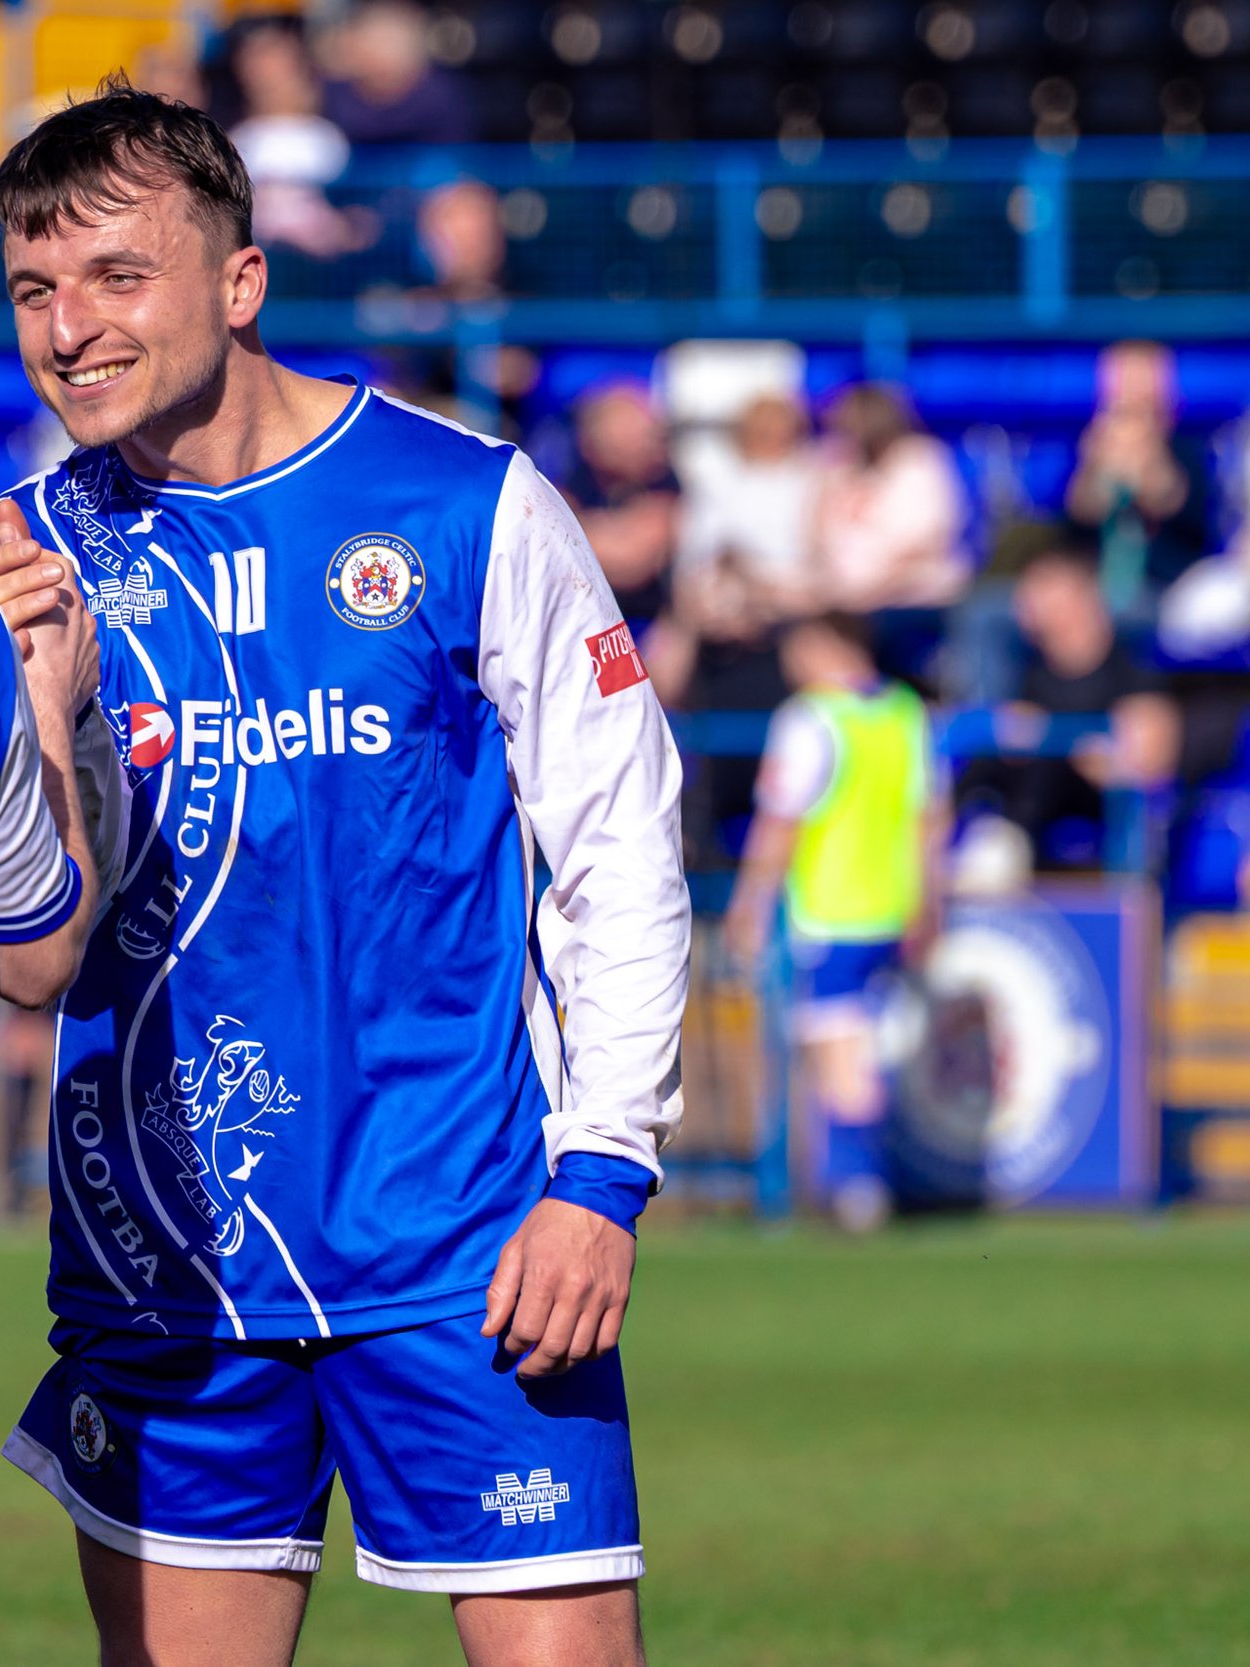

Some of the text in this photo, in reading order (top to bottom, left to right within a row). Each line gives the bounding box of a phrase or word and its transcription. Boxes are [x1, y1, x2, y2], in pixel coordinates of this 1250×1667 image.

[94, 549, 123, 573] LAB
[335, 537, 417, 569] STALYBRIDGE CELTIC
[89, 589, 166, 615] MATCHWINNER
[208, 546, 266, 636] 10
[341, 605, 410, 626] FOOTBALL CLUB
[180, 688, 392, 767] Fidelis
[177, 720, 224, 858] CLU
[148, 1114, 202, 1169] ABSQUE
[70, 1077, 159, 1289] FOOTBA
[189, 1186, 217, 1221] LAB
[484, 1485, 567, 1509] MATCHWINNER
